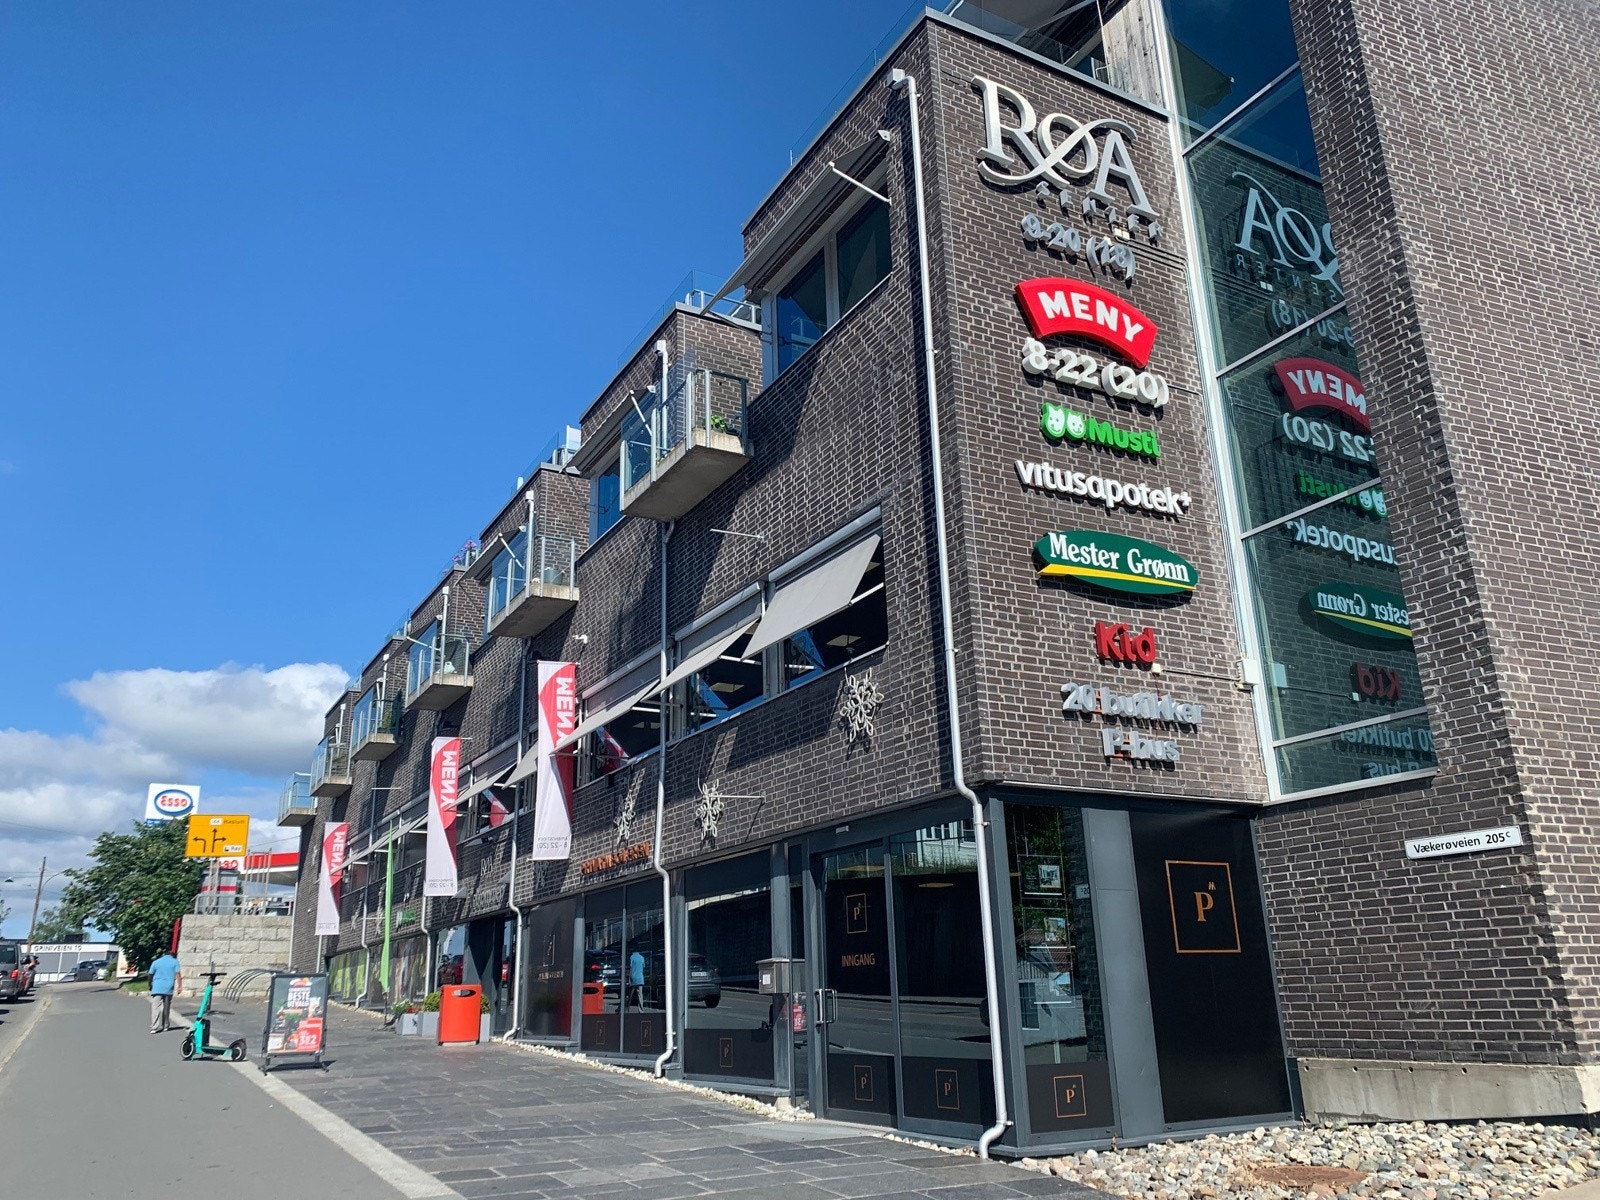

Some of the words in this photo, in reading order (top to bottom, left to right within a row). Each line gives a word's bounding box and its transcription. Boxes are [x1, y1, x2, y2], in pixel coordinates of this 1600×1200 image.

[1037, 290, 1144, 343] MENY
[1022, 337, 1099, 390] 8-22
[1102, 361, 1170, 408] (20)
[1086, 416, 1161, 458] Musti
[1048, 532, 1121, 570] Mester
[1127, 548, 1190, 582] Grønn
[1094, 620, 1157, 663] Kid
[1061, 682, 1097, 713] 20
[160, 795, 188, 808] Esso
[1413, 837, 1481, 854] Vækerøveien
[841, 953, 876, 968] INNGANG
[288, 991, 311, 1001] BESTE
